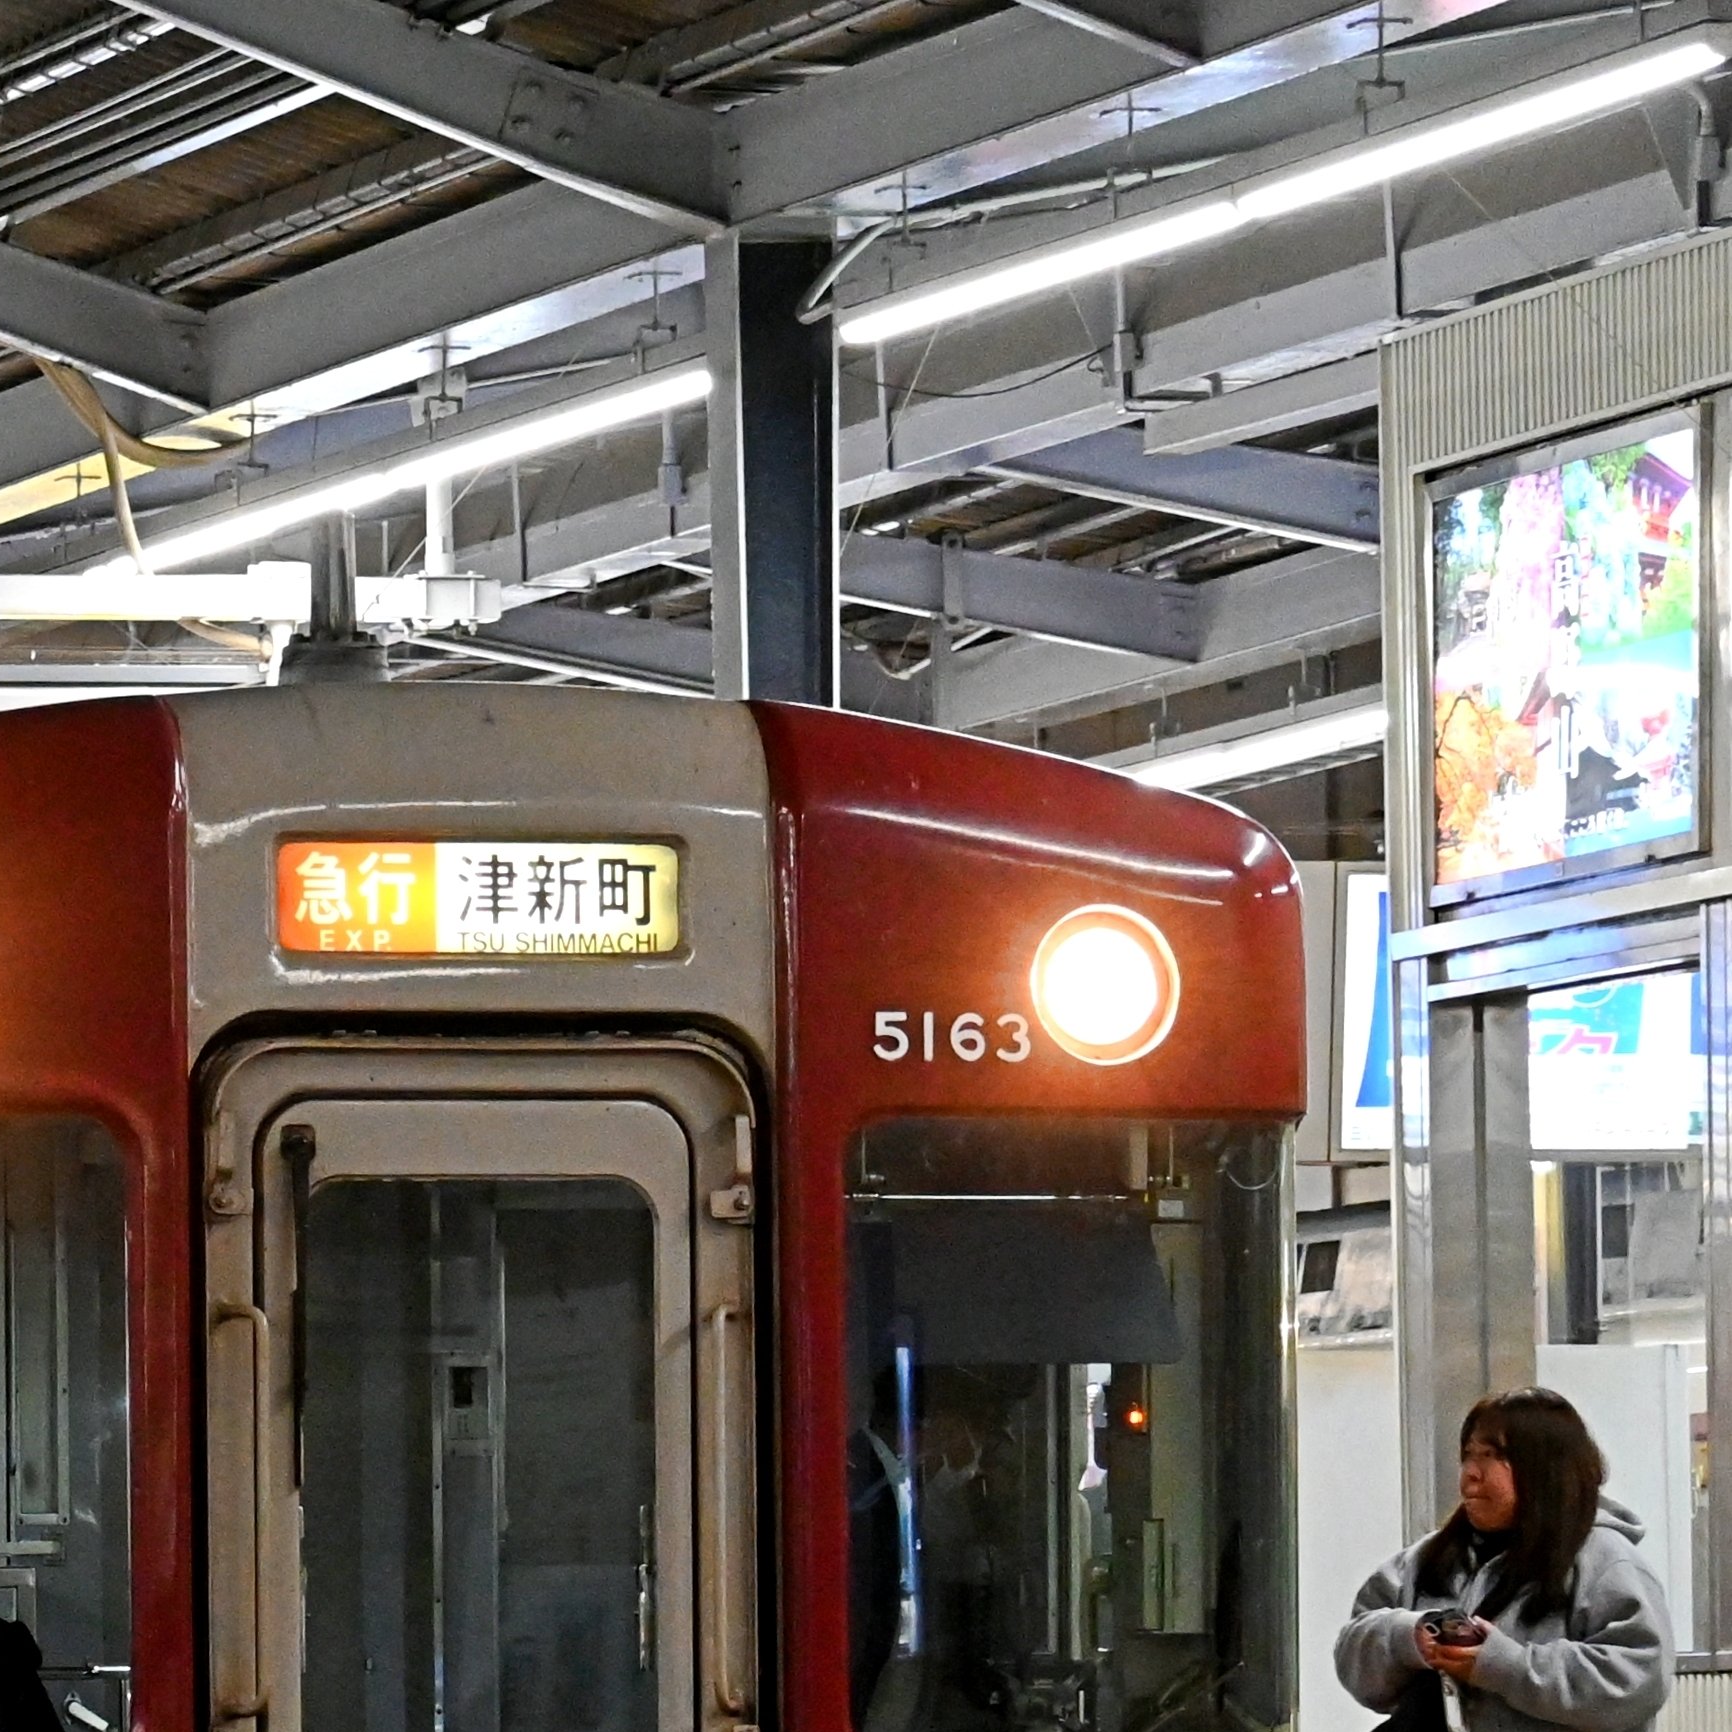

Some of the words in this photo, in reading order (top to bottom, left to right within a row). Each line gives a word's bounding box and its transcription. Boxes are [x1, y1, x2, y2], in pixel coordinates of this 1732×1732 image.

[294, 851, 416, 925] 急行
[459, 854, 656, 927] 津新町
[457, 931, 505, 952] TSU
[515, 932, 659, 954] SHIMMACHI
[872, 1011, 1032, 1063] 5163
